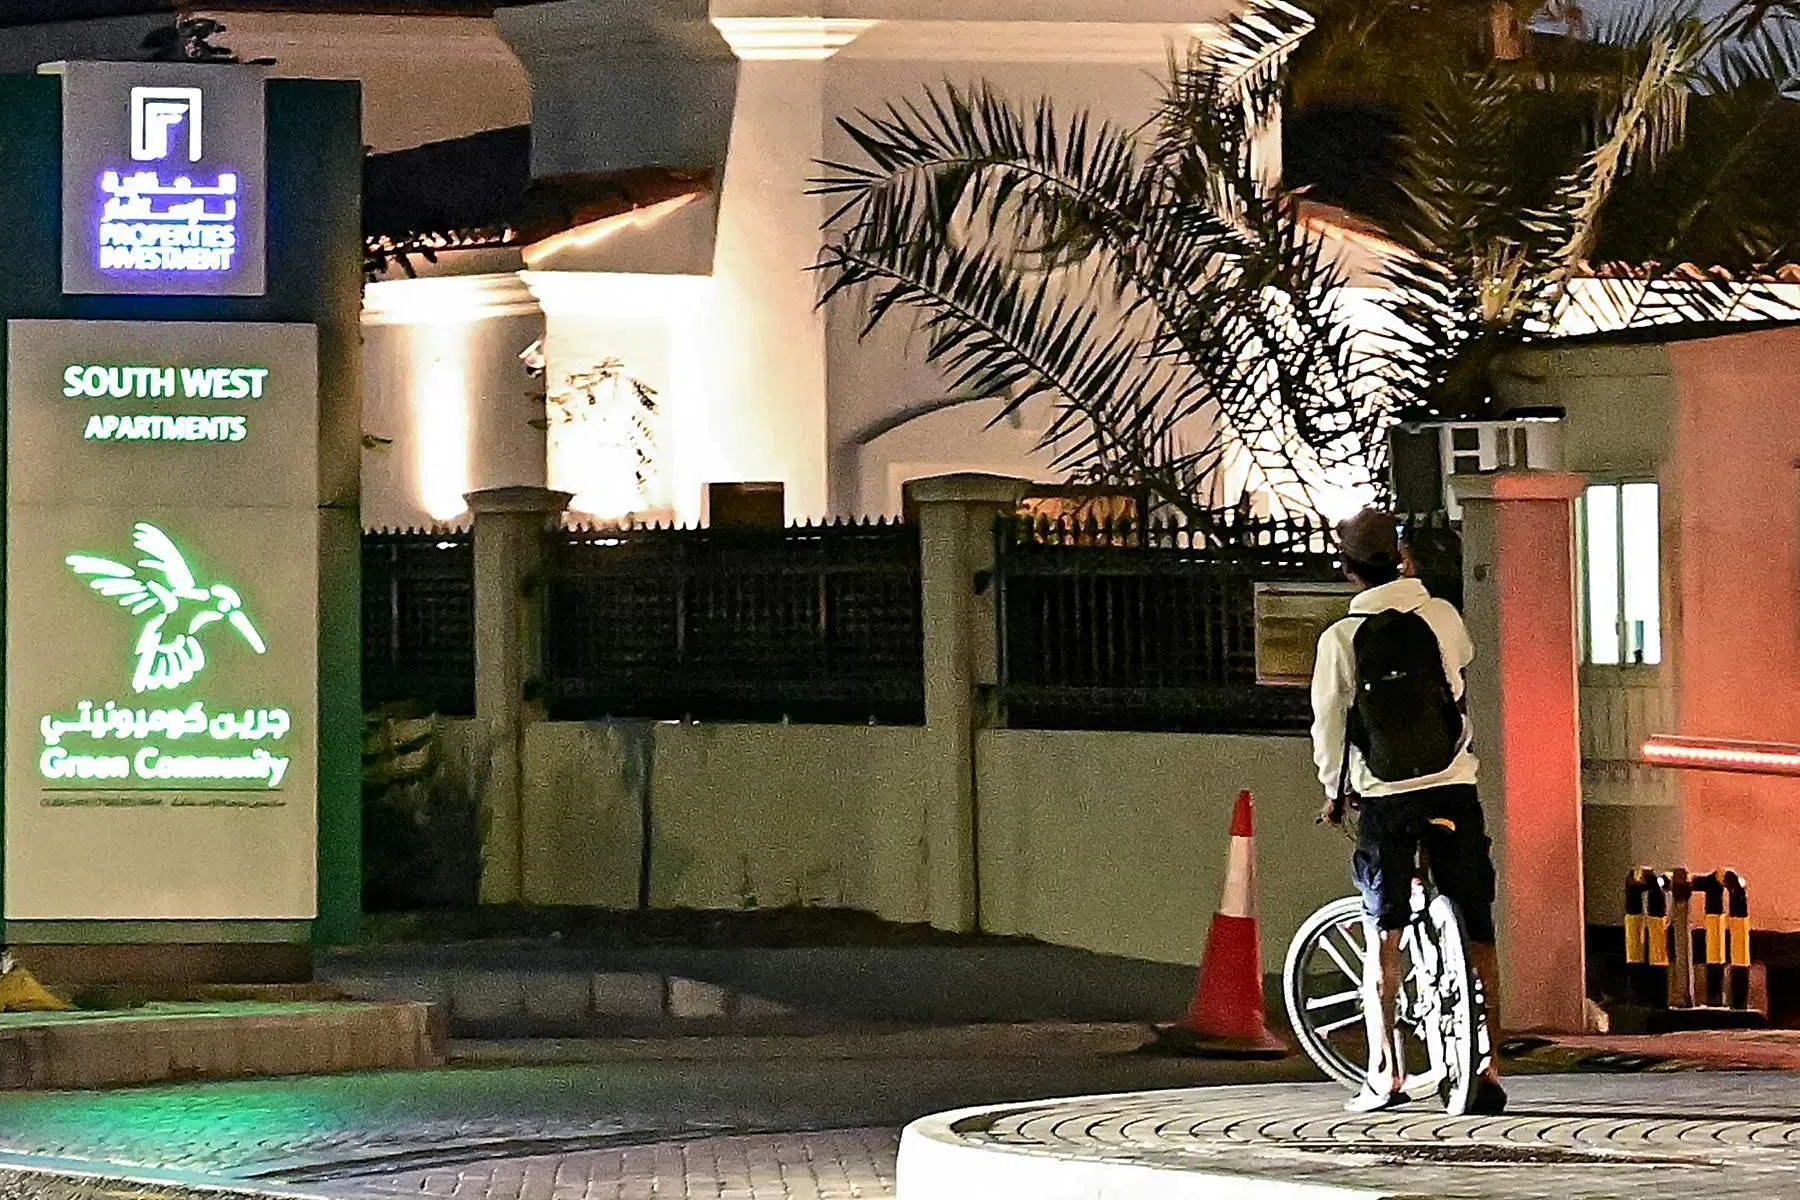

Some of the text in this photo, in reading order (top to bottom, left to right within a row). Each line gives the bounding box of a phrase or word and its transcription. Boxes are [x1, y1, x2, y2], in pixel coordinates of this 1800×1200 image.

[63, 365, 269, 399] SOUTH WEST
[84, 415, 248, 441] APARTMENTS
[39, 746, 291, 788] Green Community
